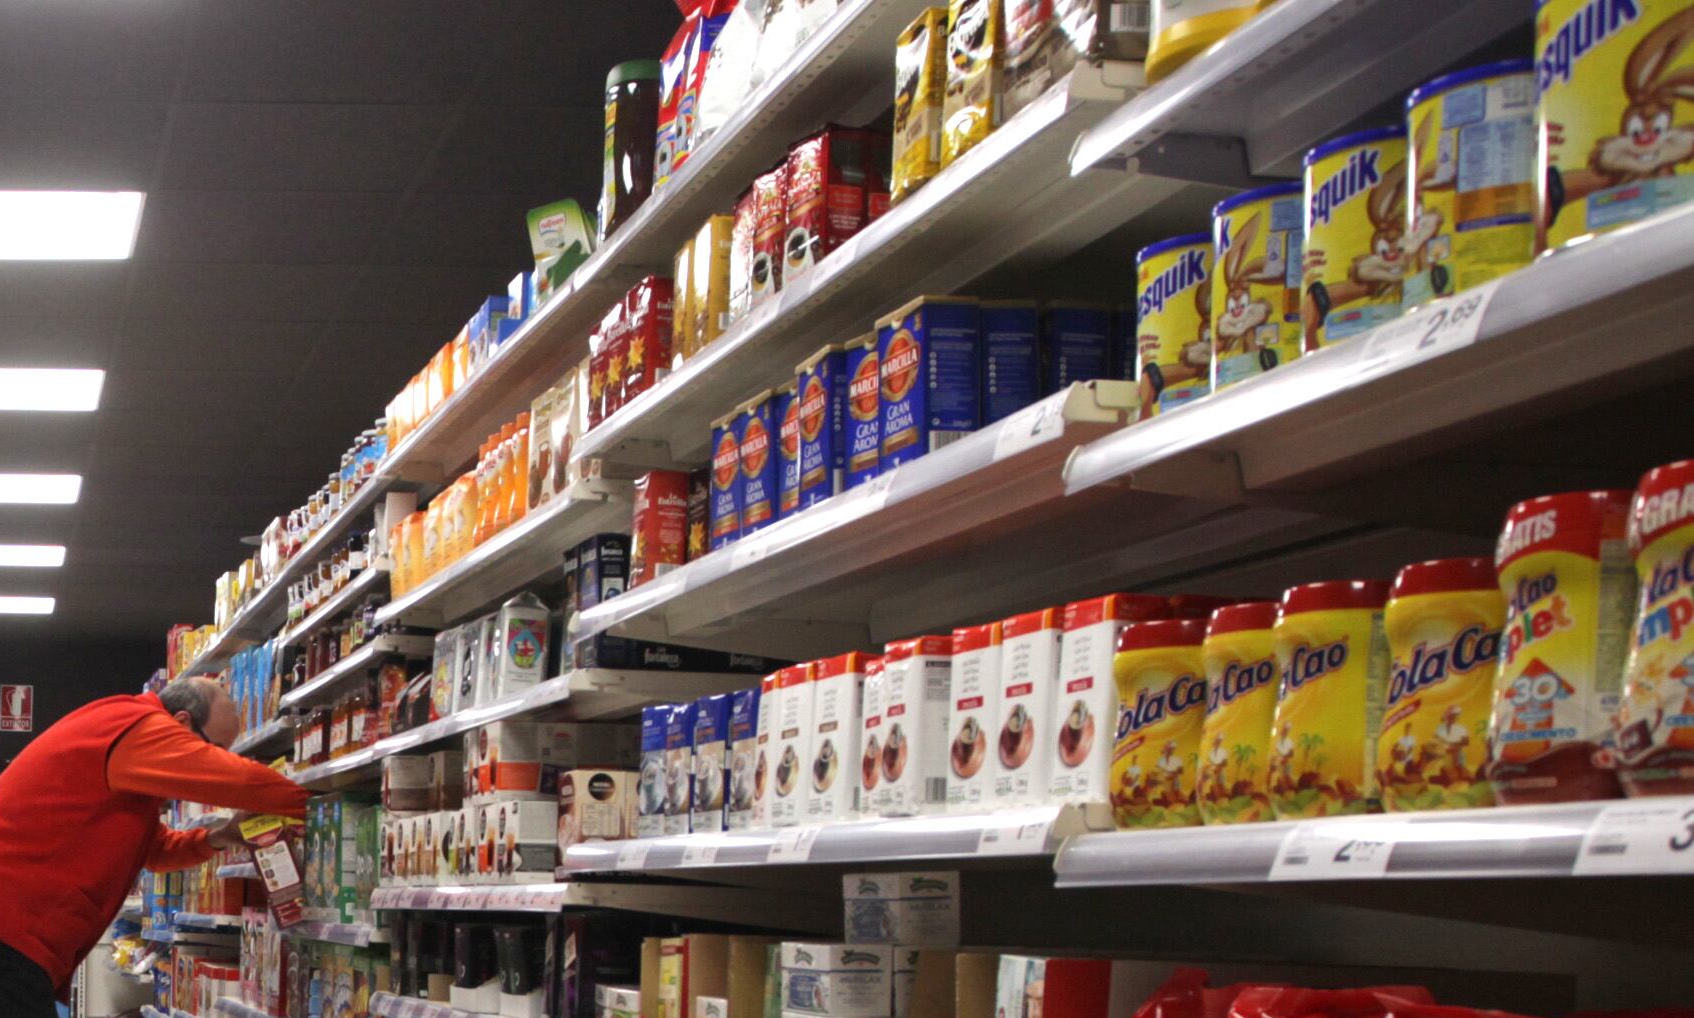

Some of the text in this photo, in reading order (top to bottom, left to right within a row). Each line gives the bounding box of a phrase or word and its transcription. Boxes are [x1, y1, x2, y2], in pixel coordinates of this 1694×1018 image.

[881, 347, 919, 375] MARCILLA
[887, 399, 911, 421] GRAN
[884, 414, 914, 436] AROMA
[741, 433, 768, 457] MARCILLA
[1641, 484, 1694, 536] GRA
[1514, 674, 1559, 703] 30
